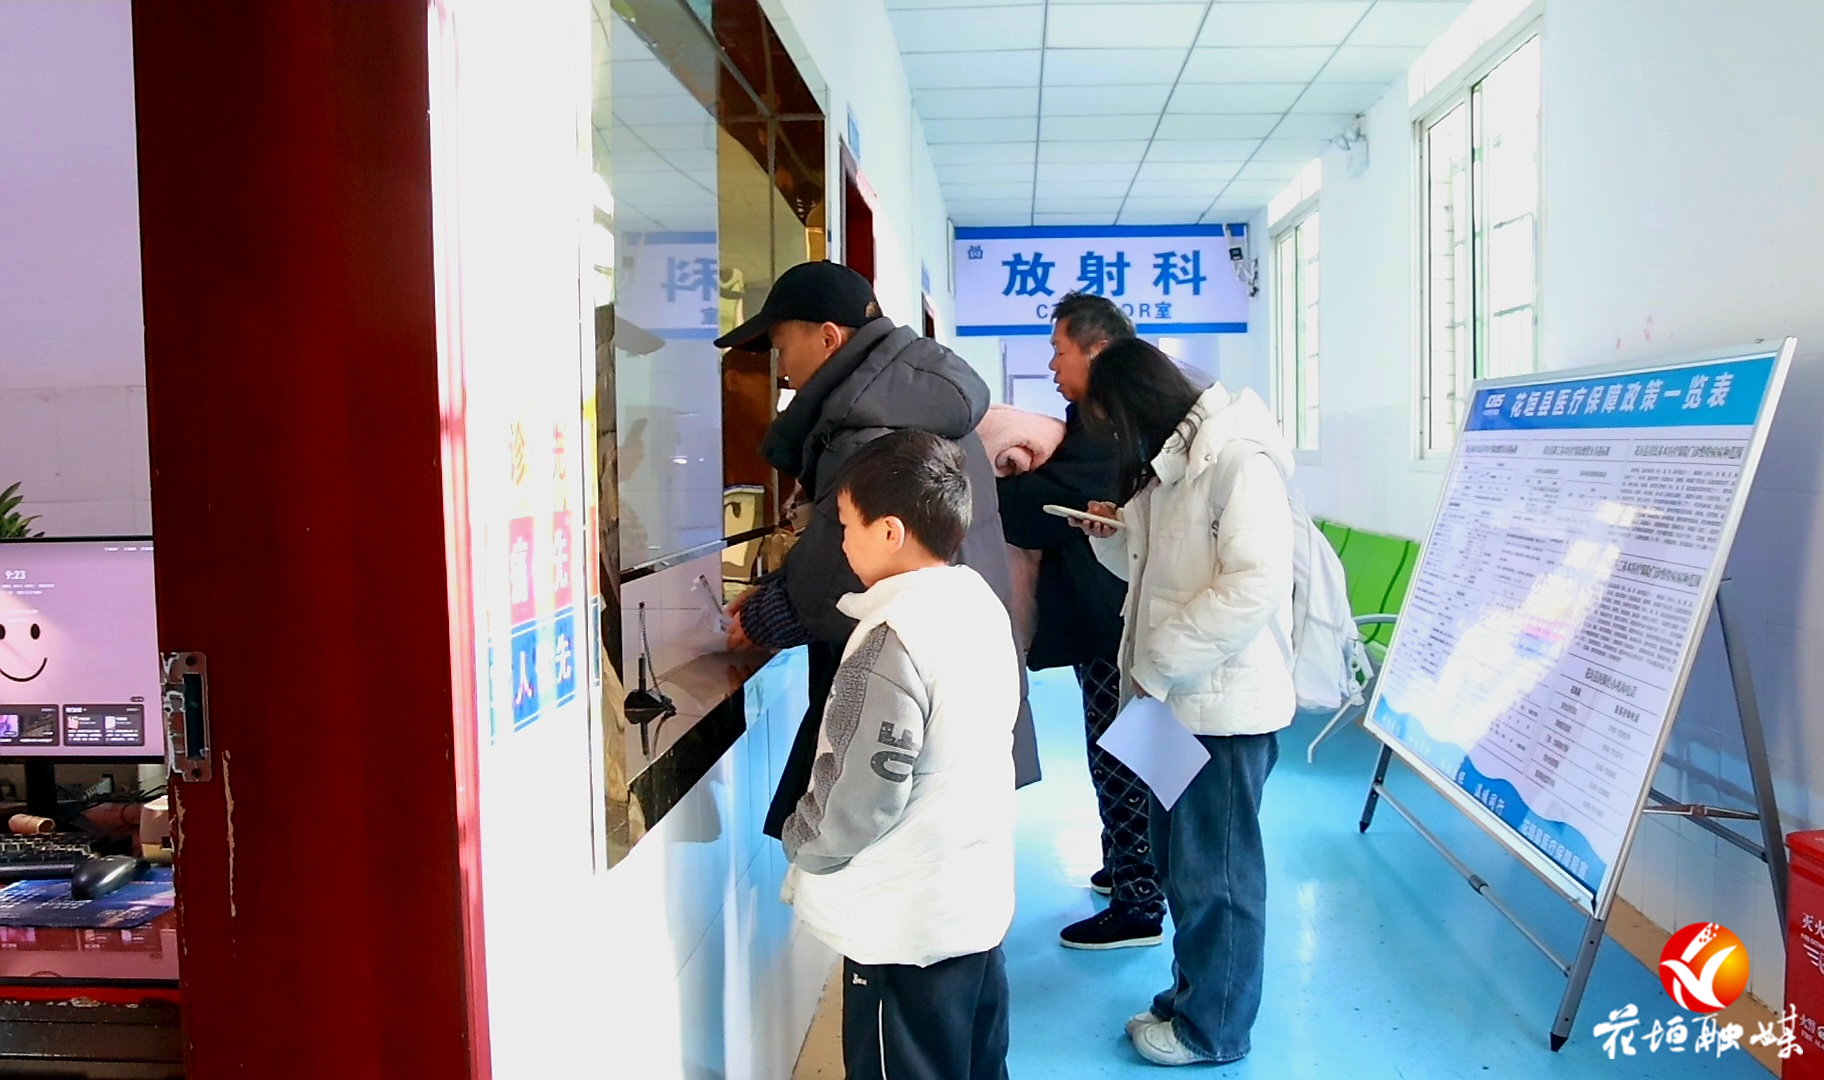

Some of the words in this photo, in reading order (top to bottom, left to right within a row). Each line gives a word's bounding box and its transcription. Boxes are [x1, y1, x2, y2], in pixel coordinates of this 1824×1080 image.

[1002, 250, 1207, 297] 放射科
[1510, 371, 1735, 418] 花垣县医疗保障政策一览表
[5, 570, 26, 580] 9:23
